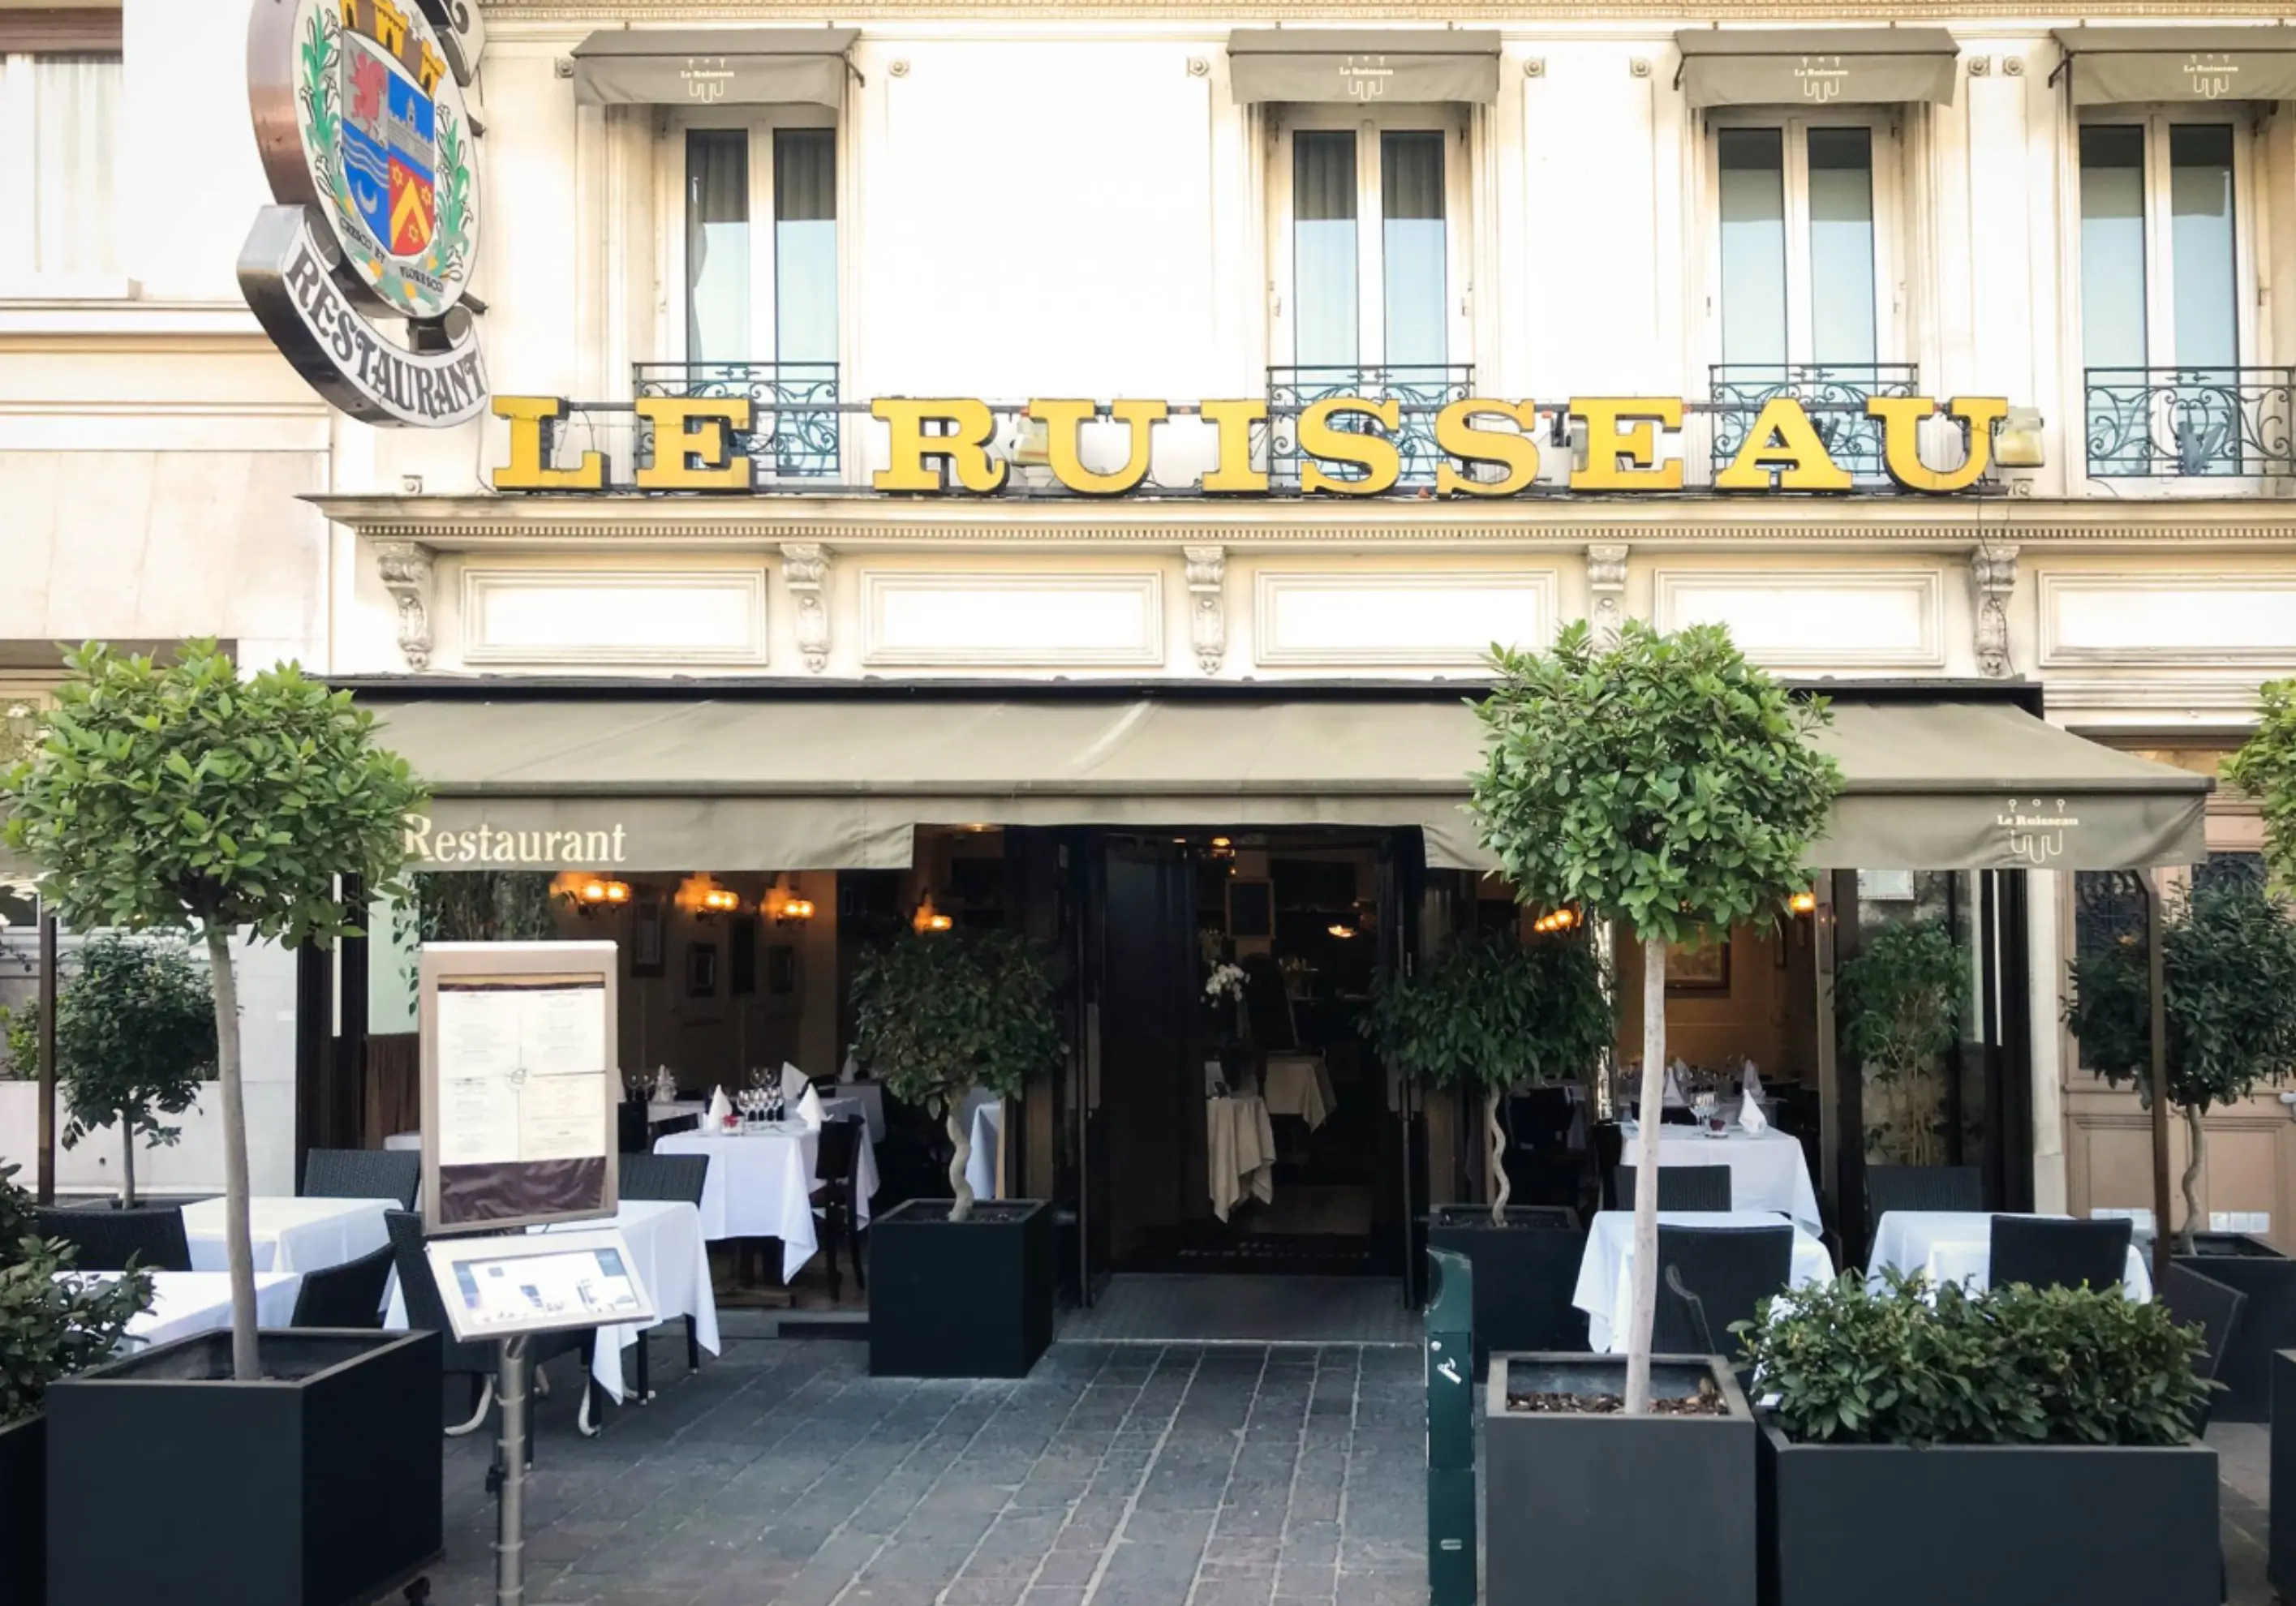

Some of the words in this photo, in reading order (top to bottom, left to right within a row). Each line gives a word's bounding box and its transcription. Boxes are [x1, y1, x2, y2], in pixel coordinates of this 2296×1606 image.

[286, 242, 486, 419] RESTAURANT
[492, 395, 756, 492] LE
[871, 396, 2008, 496] RUISSEAU
[402, 813, 626, 862] Restaurant
